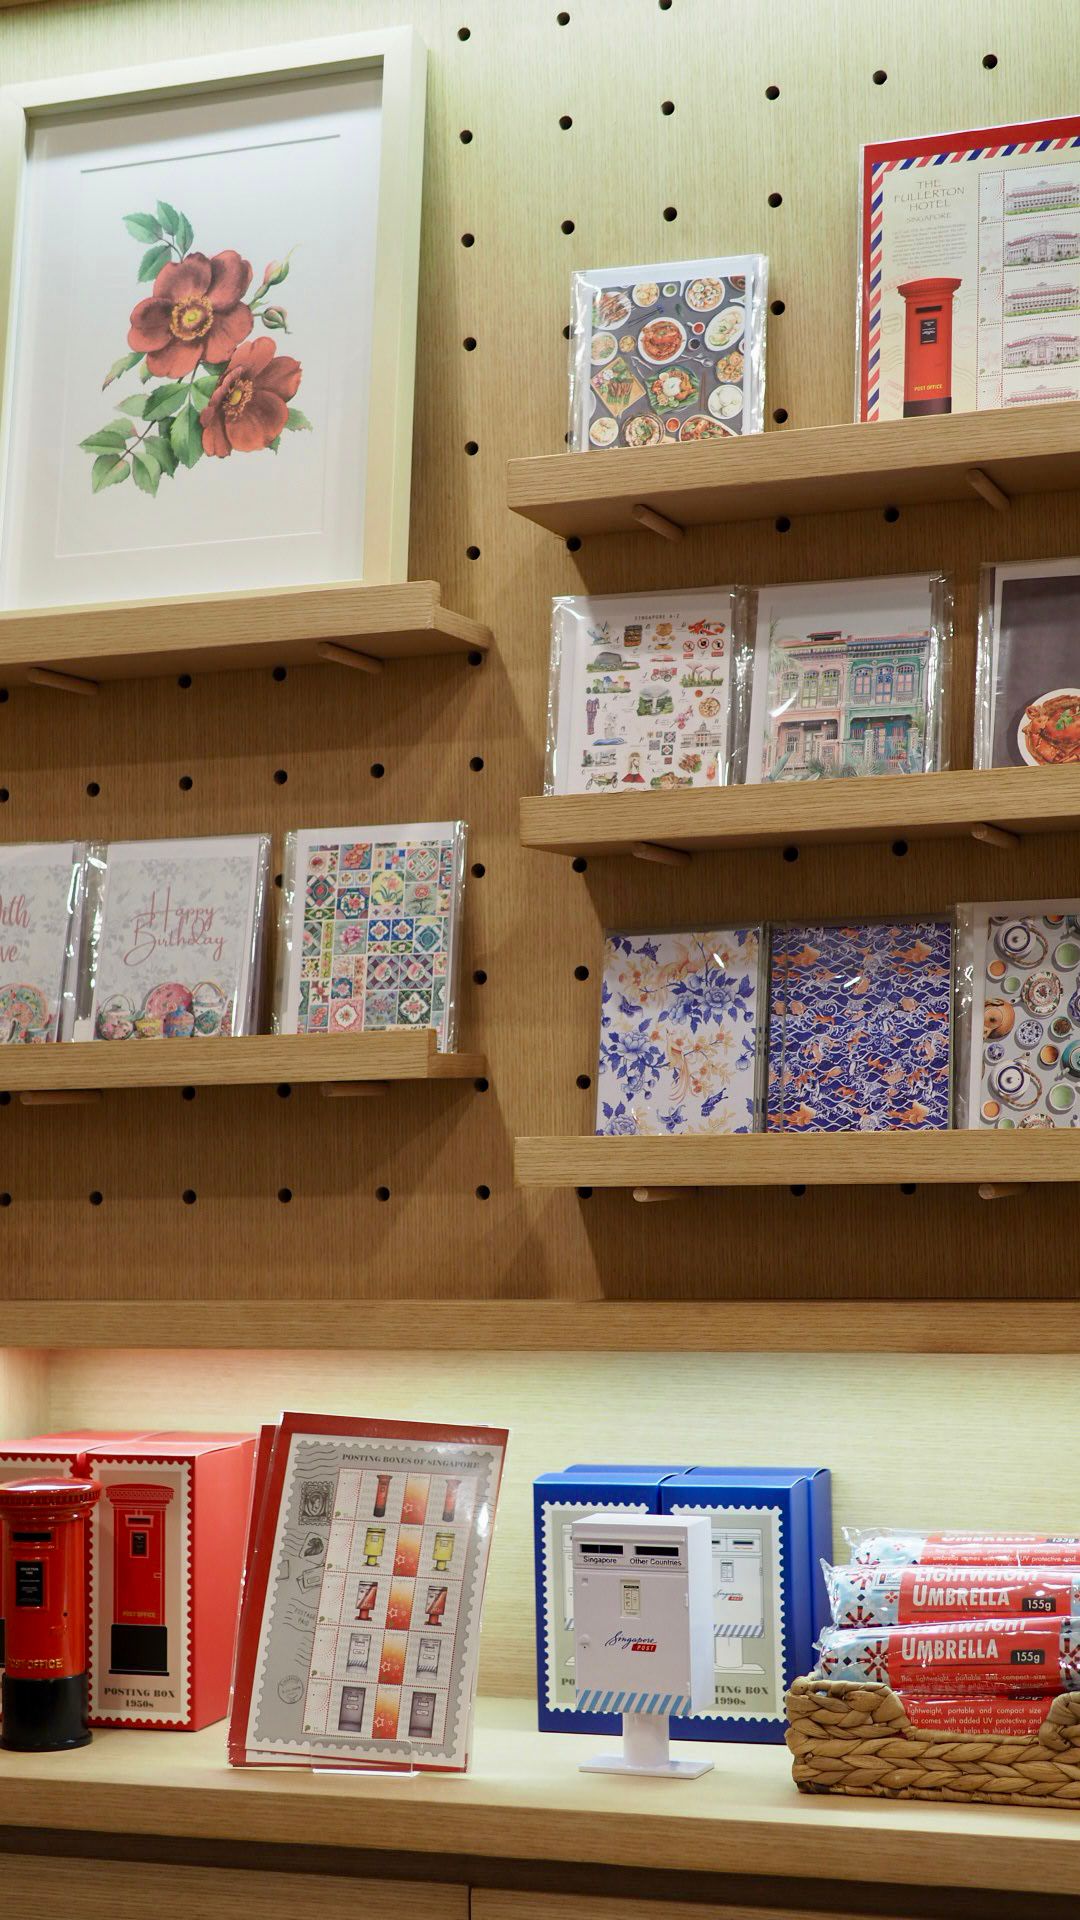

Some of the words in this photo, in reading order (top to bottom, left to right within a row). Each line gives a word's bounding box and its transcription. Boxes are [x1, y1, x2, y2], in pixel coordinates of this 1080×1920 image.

[915, 179, 941, 189] THE
[894, 187, 964, 203] FULLERTON
[909, 199, 951, 211] HOTEL
[149, 886, 217, 932] Happy
[123, 912, 227, 967] Birthday
[341, 1453, 381, 1463] POSTING
[383, 1456, 412, 1465] BOXES
[427, 1459, 480, 1469] SINGAPORE
[583, 1555, 617, 1565] Singapore
[629, 1558, 649, 1566] Other
[650, 1558, 682, 1567] Countries
[912, 1584, 1010, 1606] UMBRELLA
[1027, 1600, 1052, 1612] 155g
[604, 1630, 657, 1649] Singapore
[636, 1643, 656, 1652] POST
[901, 1637, 999, 1661] UMBRELLA
[1016, 1652, 1040, 1664] 155g
[104, 1687, 150, 1697] POSTING
[154, 1689, 175, 1698] BOX
[715, 1685, 742, 1694] TING
[745, 1686, 769, 1695] BOX
[126, 1700, 154, 1708] 1950s
[715, 1697, 746, 1705] 1990s
[948, 1707, 975, 1715] portable
[996, 1707, 1025, 1715] compact
[996, 1717, 1026, 1726] protective
[1029, 1716, 1042, 1724] and
[964, 1727, 980, 1735] helps
